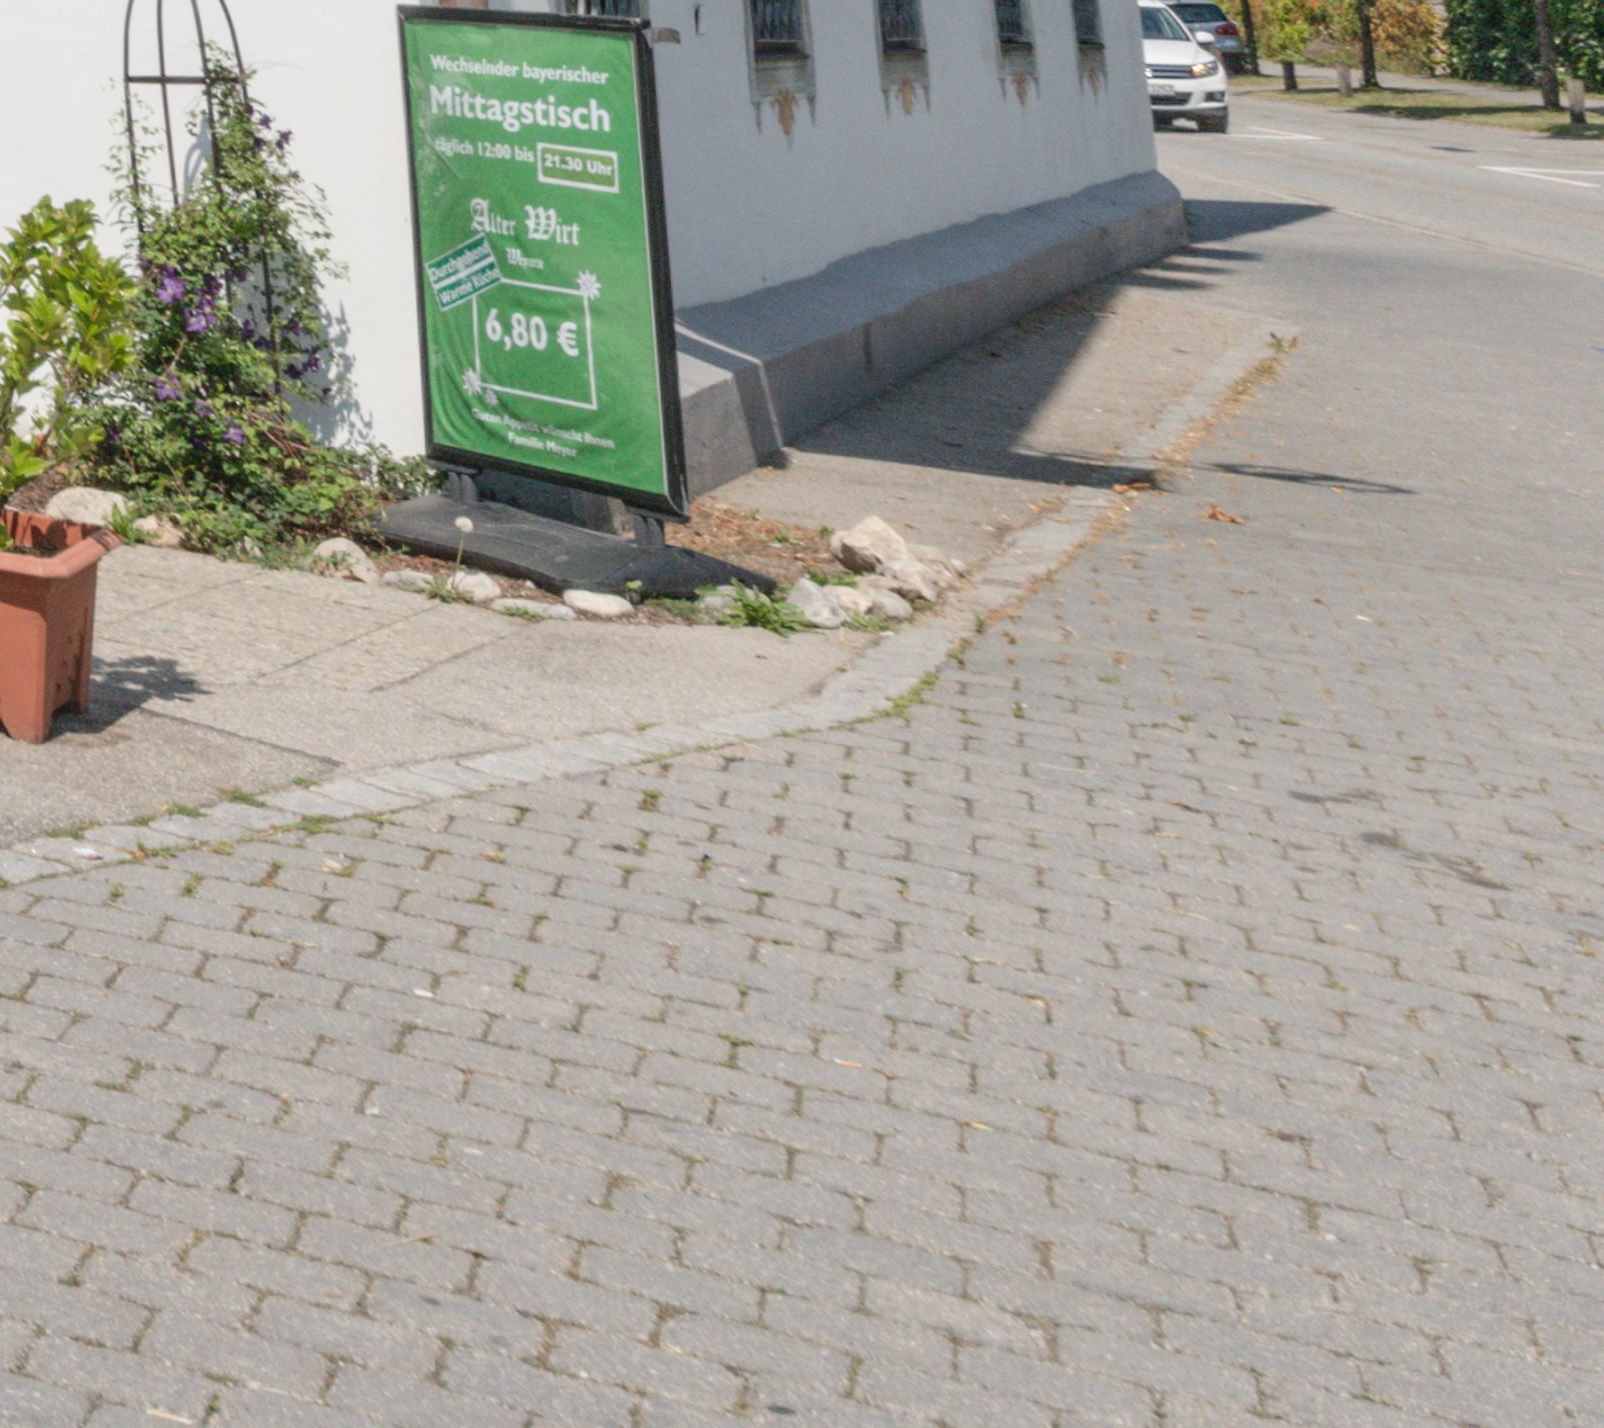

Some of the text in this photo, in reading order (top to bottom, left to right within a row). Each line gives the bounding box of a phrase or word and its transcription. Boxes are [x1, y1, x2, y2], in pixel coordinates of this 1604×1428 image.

[430, 54, 609, 84] Wechselnder bayerischer
[429, 84, 611, 133] Mittagstisch
[435, 137, 534, 162] täglich 12:00 bis
[544, 153, 613, 176] 21.30 Uhr
[470, 197, 580, 246] Alter Wirt
[429, 245, 490, 280] Durchgehend
[440, 265, 501, 304] Warme Küche
[485, 308, 579, 357] 6,80 €
[507, 432, 544, 450] Familie
